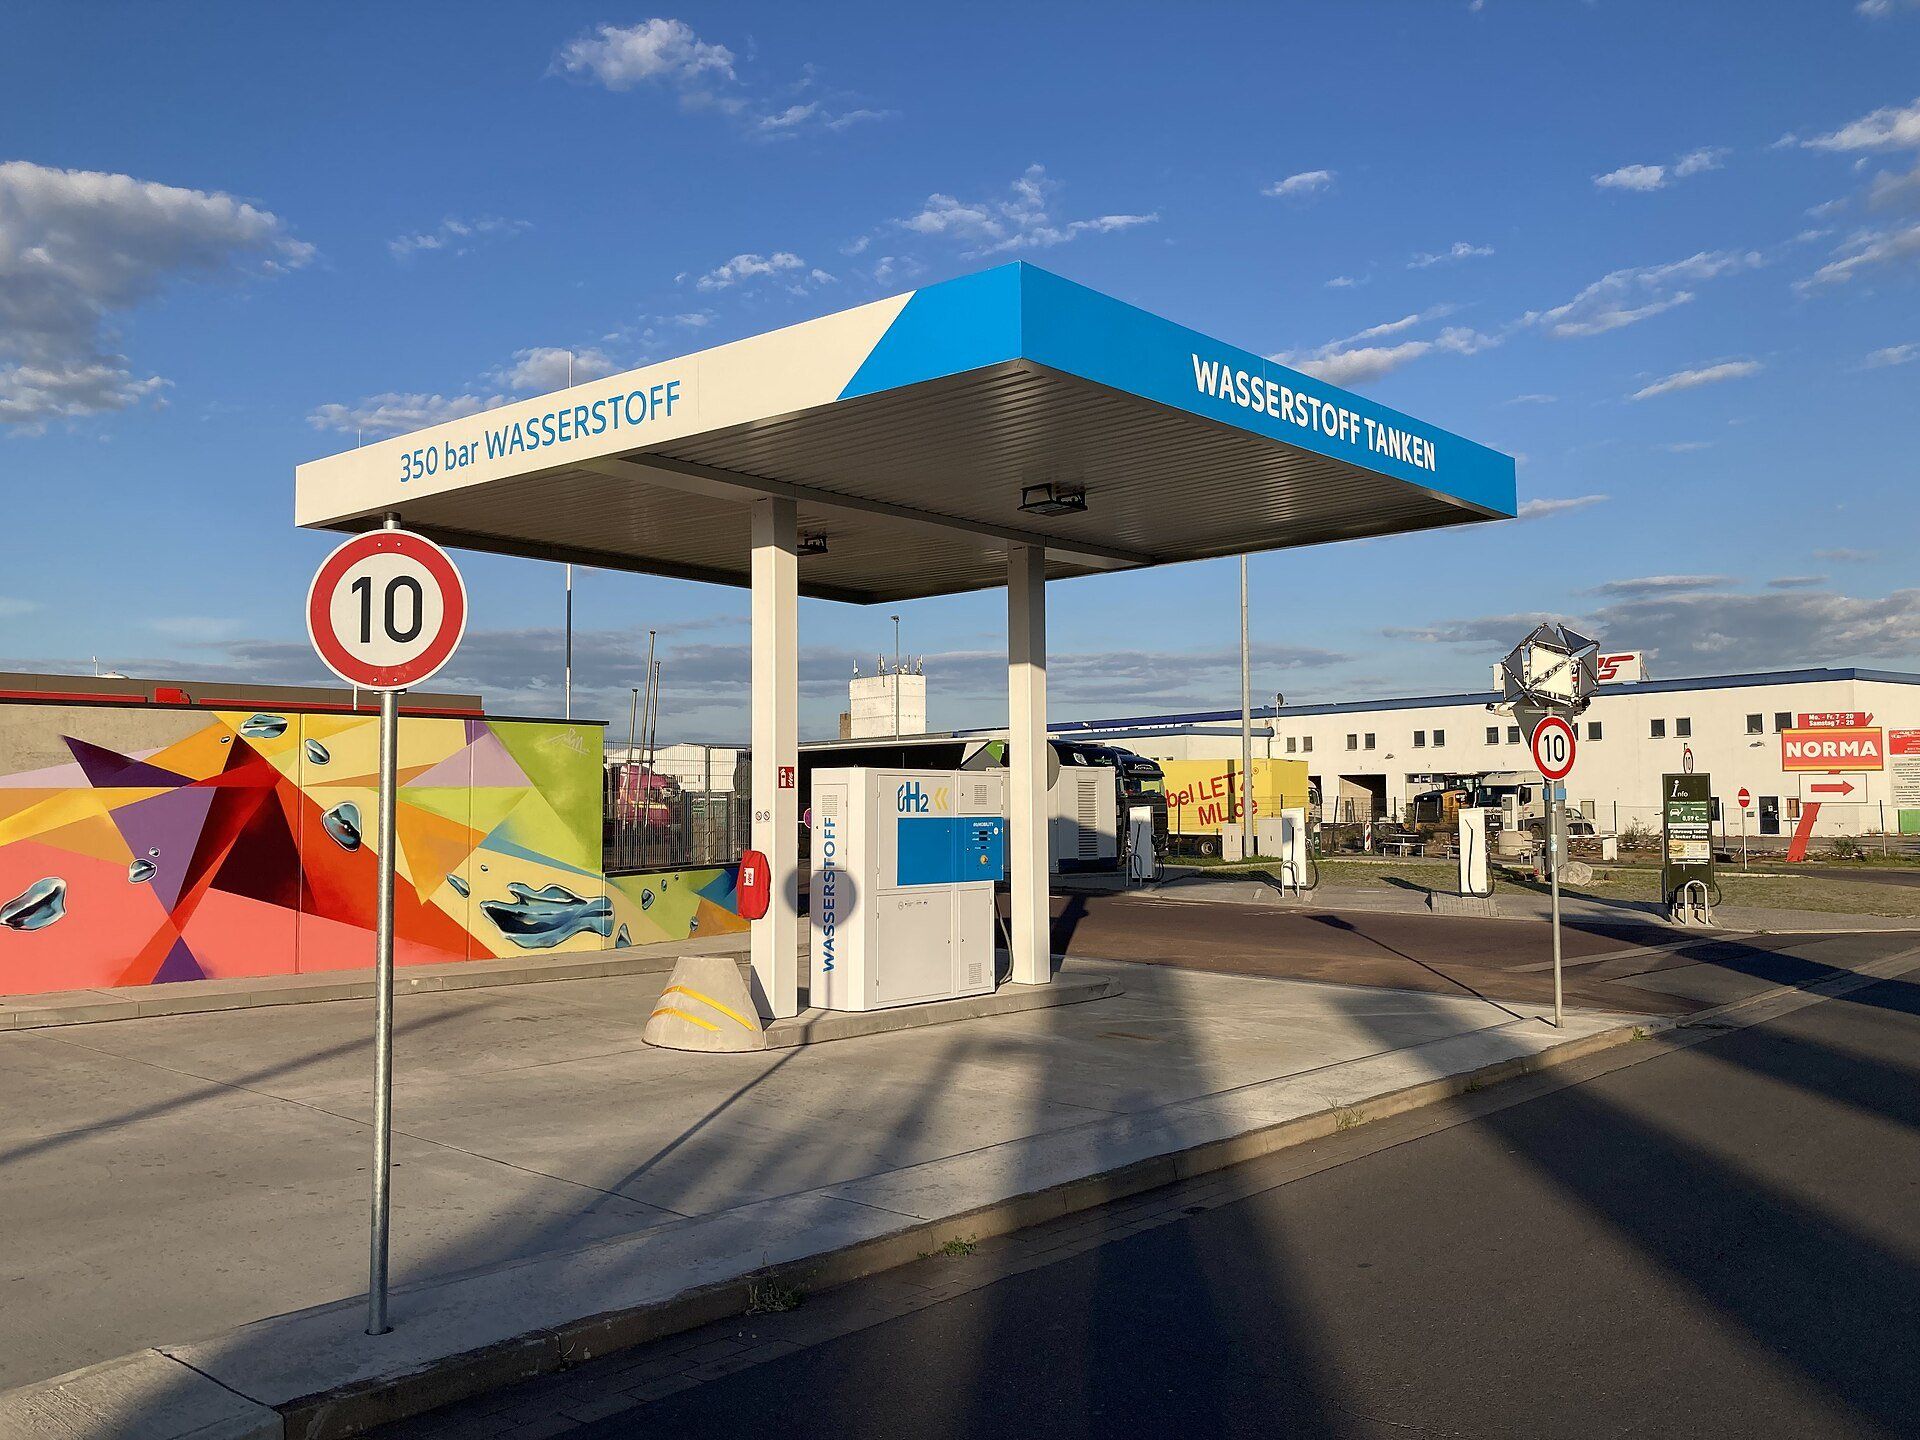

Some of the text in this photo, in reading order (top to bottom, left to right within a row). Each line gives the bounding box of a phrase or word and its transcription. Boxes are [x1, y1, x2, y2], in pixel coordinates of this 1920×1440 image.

[400, 380, 681, 483] 350 bar WASSERSTOFF
[1191, 353, 1436, 472] WASSERSTOFF TANKEN
[351, 575, 423, 644] 10
[1543, 734, 1565, 762] 10
[1786, 741, 1878, 758] NORMA
[822, 817, 836, 973] WASSERSTOFF
